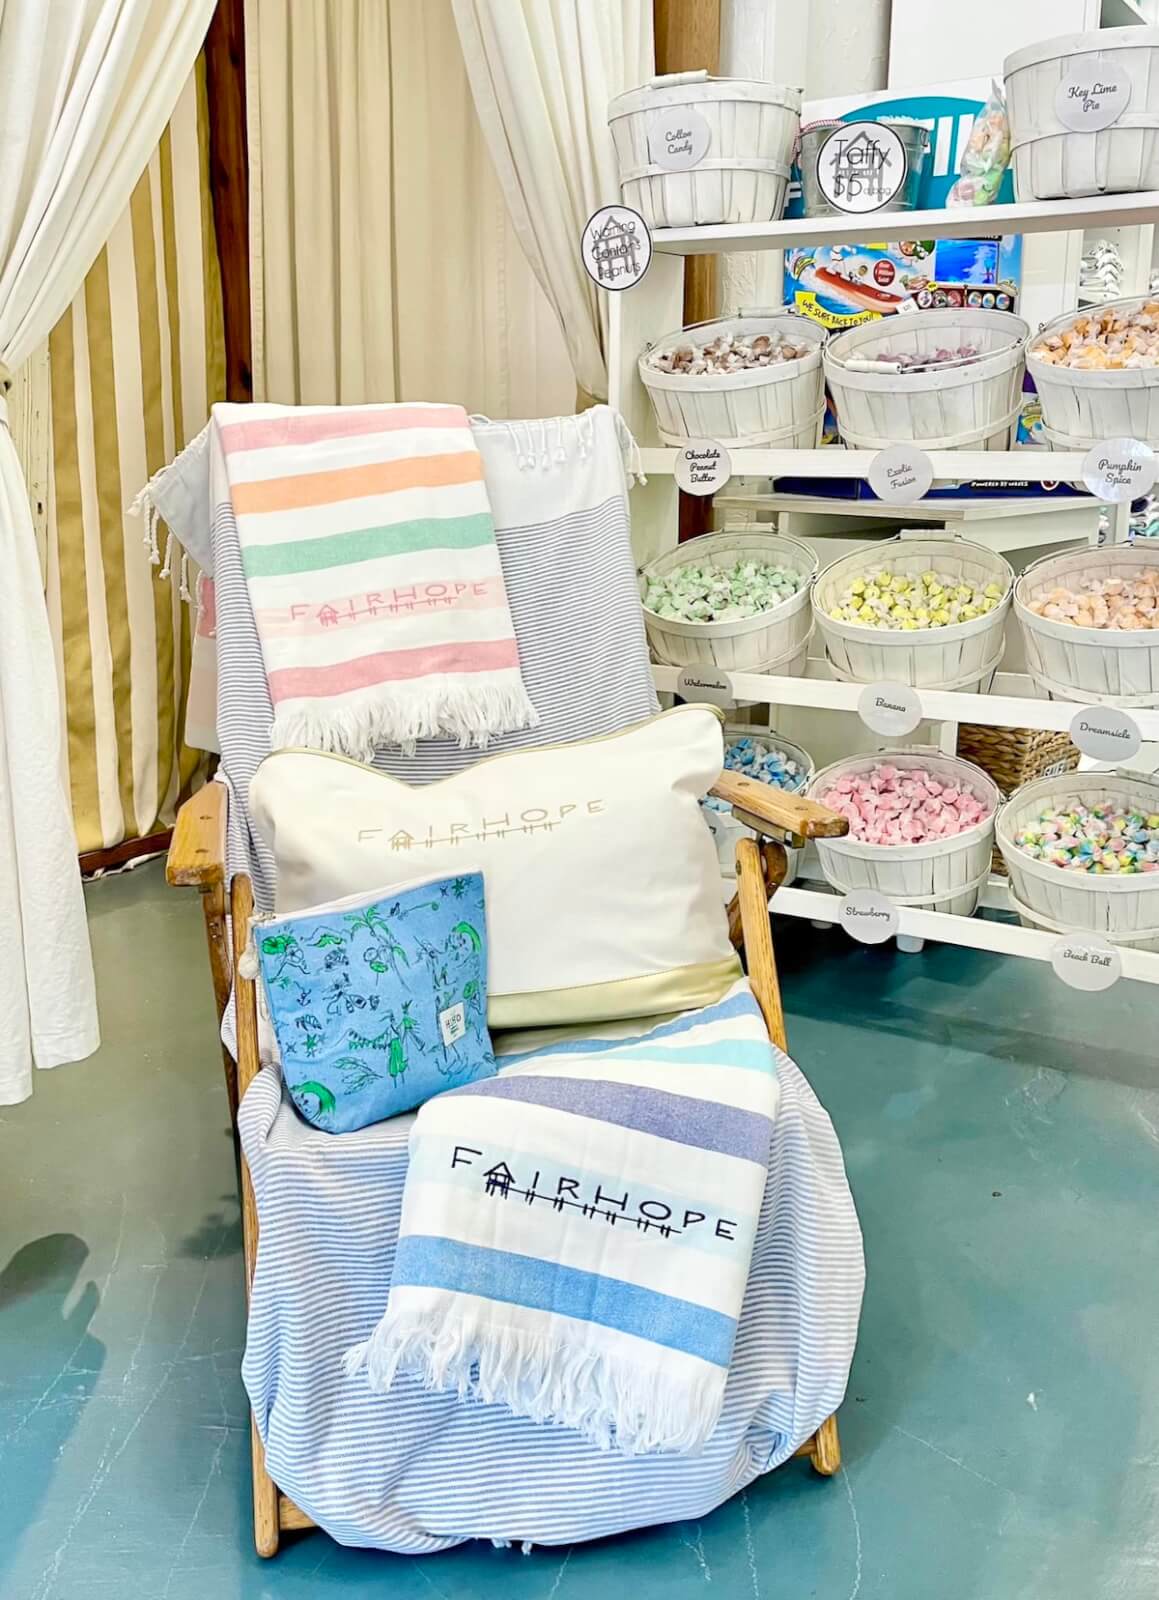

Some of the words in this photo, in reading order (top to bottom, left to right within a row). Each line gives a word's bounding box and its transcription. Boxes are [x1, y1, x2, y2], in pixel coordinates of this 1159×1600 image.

[1068, 86, 1089, 101] Key
[1091, 83, 1117, 95] Lime
[1083, 99, 1100, 112] Pie
[665, 128, 692, 142] Cotton
[667, 140, 693, 155] Candy
[833, 139, 891, 170] Taffy
[835, 173, 862, 197] $5
[685, 449, 720, 460] Chocolate
[690, 461, 717, 472] Peanut
[887, 463, 913, 478] Exotic
[1098, 459, 1142, 475] Pumpkin
[690, 472, 716, 483] Butter
[890, 476, 916, 489] Fusion
[1105, 472, 1132, 488] Spice
[290, 583, 489, 624] FAIRHOPE
[684, 679, 727, 690] Watermelon
[875, 697, 906, 712] Banana
[1080, 722, 1131, 739] Dreamsicle
[358, 800, 605, 849] FAIRHOPE
[846, 906, 890, 921] Strawberry
[1063, 949, 1089, 961] Beach
[1090, 954, 1112, 967] Ball
[451, 1146, 738, 1240] FAIRHOPE
